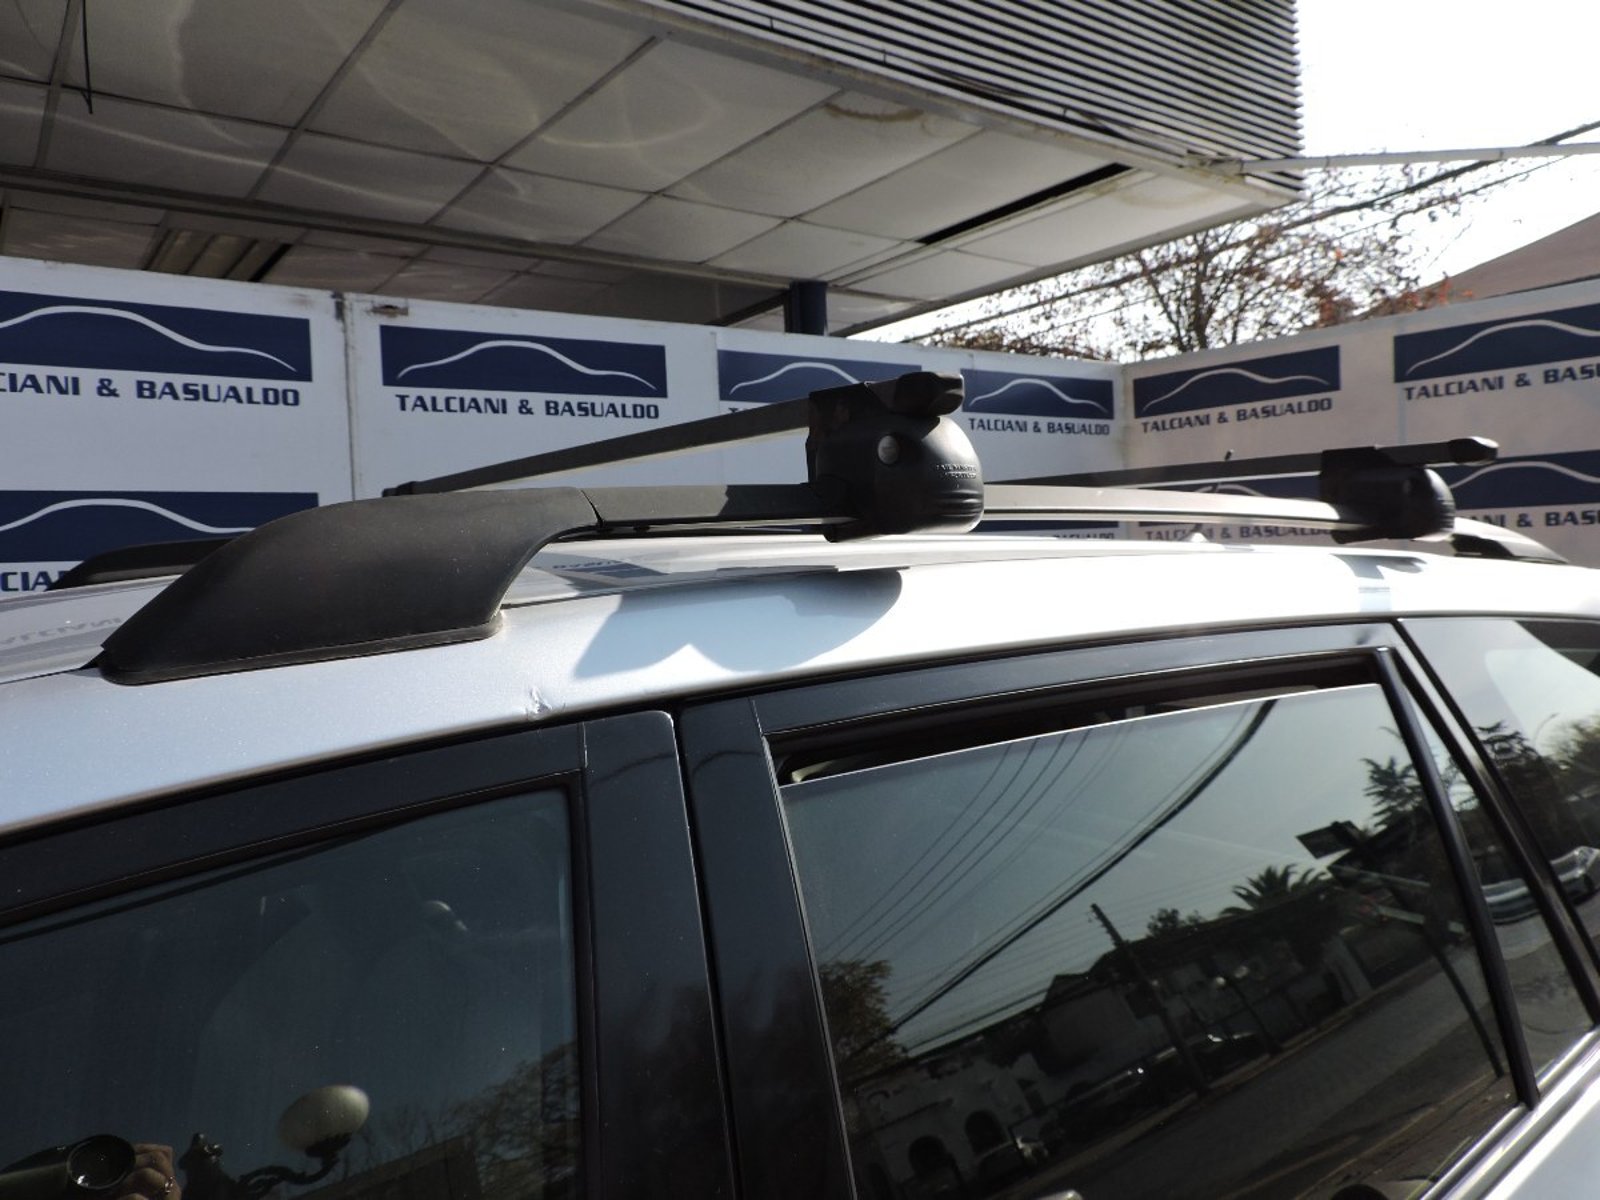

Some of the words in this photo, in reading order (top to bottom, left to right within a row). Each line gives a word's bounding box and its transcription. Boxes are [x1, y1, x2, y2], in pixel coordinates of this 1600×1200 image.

[97, 378, 119, 397] &
[136, 380, 300, 406] BASUALDO
[1404, 376, 1504, 400] TALCIANI
[1515, 373, 1531, 387] &
[1544, 363, 1600, 384] BAS
[395, 394, 507, 414] TALCIANI
[518, 399, 534, 415] &
[545, 400, 659, 419] BASUALDO
[1142, 414, 1210, 433] TALCIANI
[1217, 411, 1228, 423] &
[1236, 398, 1332, 422] BASUALDO
[969, 418, 1027, 432] TALCIANI
[1033, 421, 1041, 433] &
[1047, 422, 1110, 435] BASUALDO
[1517, 513, 1532, 527] &
[1545, 510, 1600, 526] BAS
[1220, 528, 1231, 539] &
